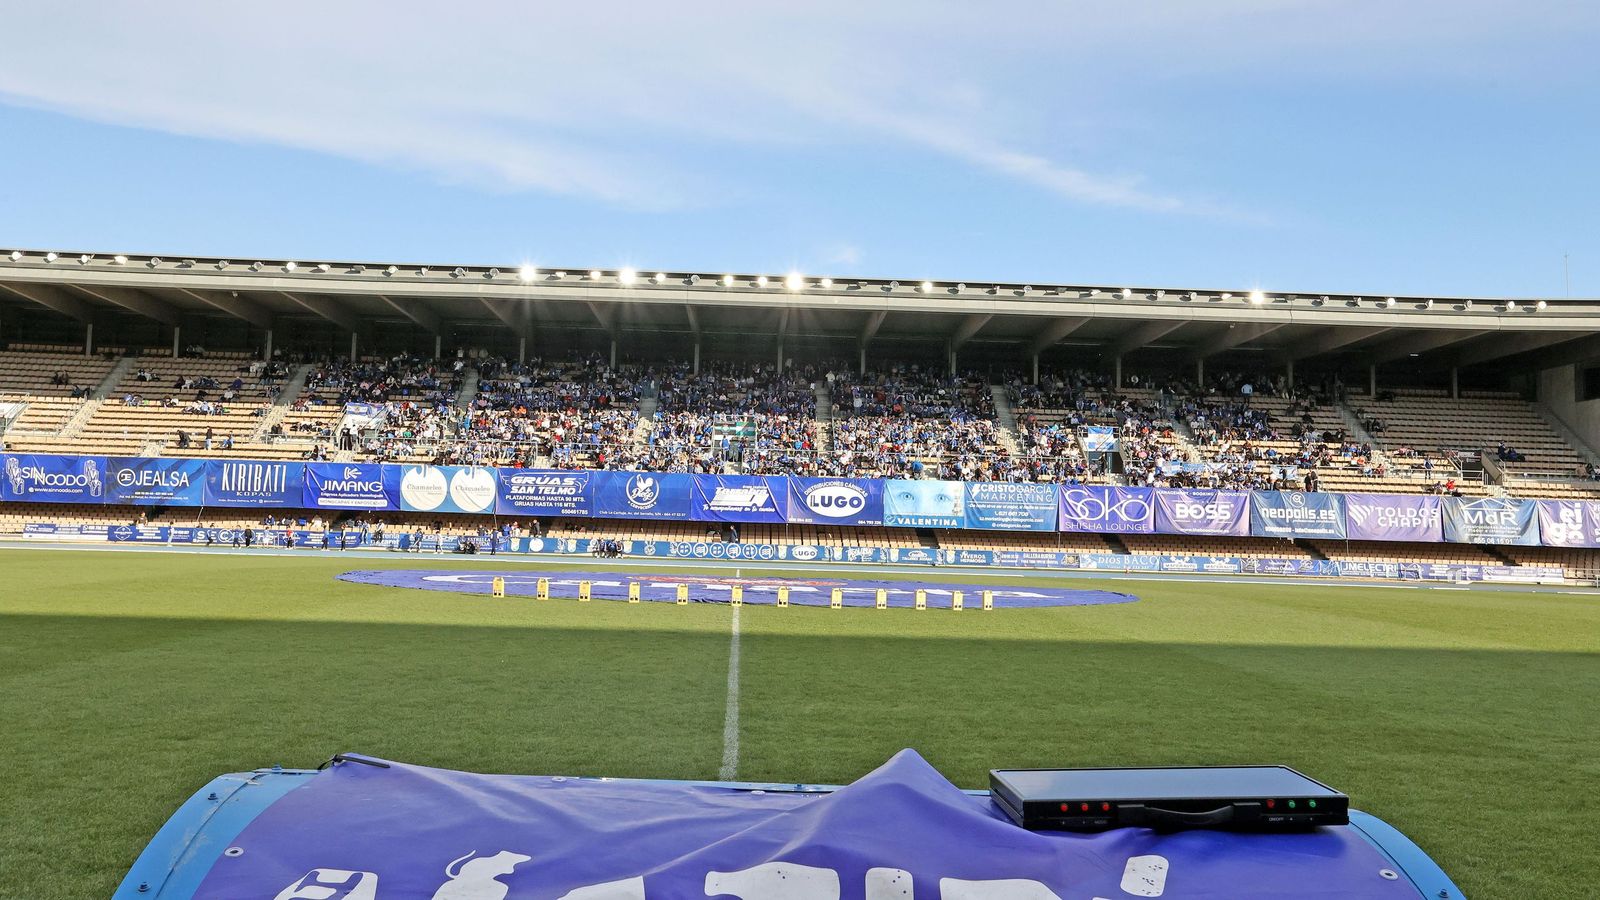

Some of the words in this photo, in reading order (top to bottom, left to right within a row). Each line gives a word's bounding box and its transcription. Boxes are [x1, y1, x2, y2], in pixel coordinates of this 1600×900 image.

[21, 466, 45, 479] SIN
[135, 470, 190, 487] JEALSA
[221, 463, 287, 493] KIRIBATI
[34, 473, 88, 487] NOODO
[320, 480, 384, 493] JIMANG
[510, 475, 577, 486] GRÚAS
[510, 485, 536, 494] SAN
[538, 486, 577, 496] TELMO
[810, 495, 863, 509] LUGO
[980, 493, 1053, 502] MARKETING
[1262, 507, 1336, 523] neopolis.es
[1375, 506, 1440, 518] TOLDOS
[1463, 510, 1518, 526] MdR
[897, 517, 958, 527] VALENTINA
[1065, 521, 1103, 531] SHISHA
[1105, 523, 1149, 532] LOUNGE
[1124, 555, 1159, 565] BACO
